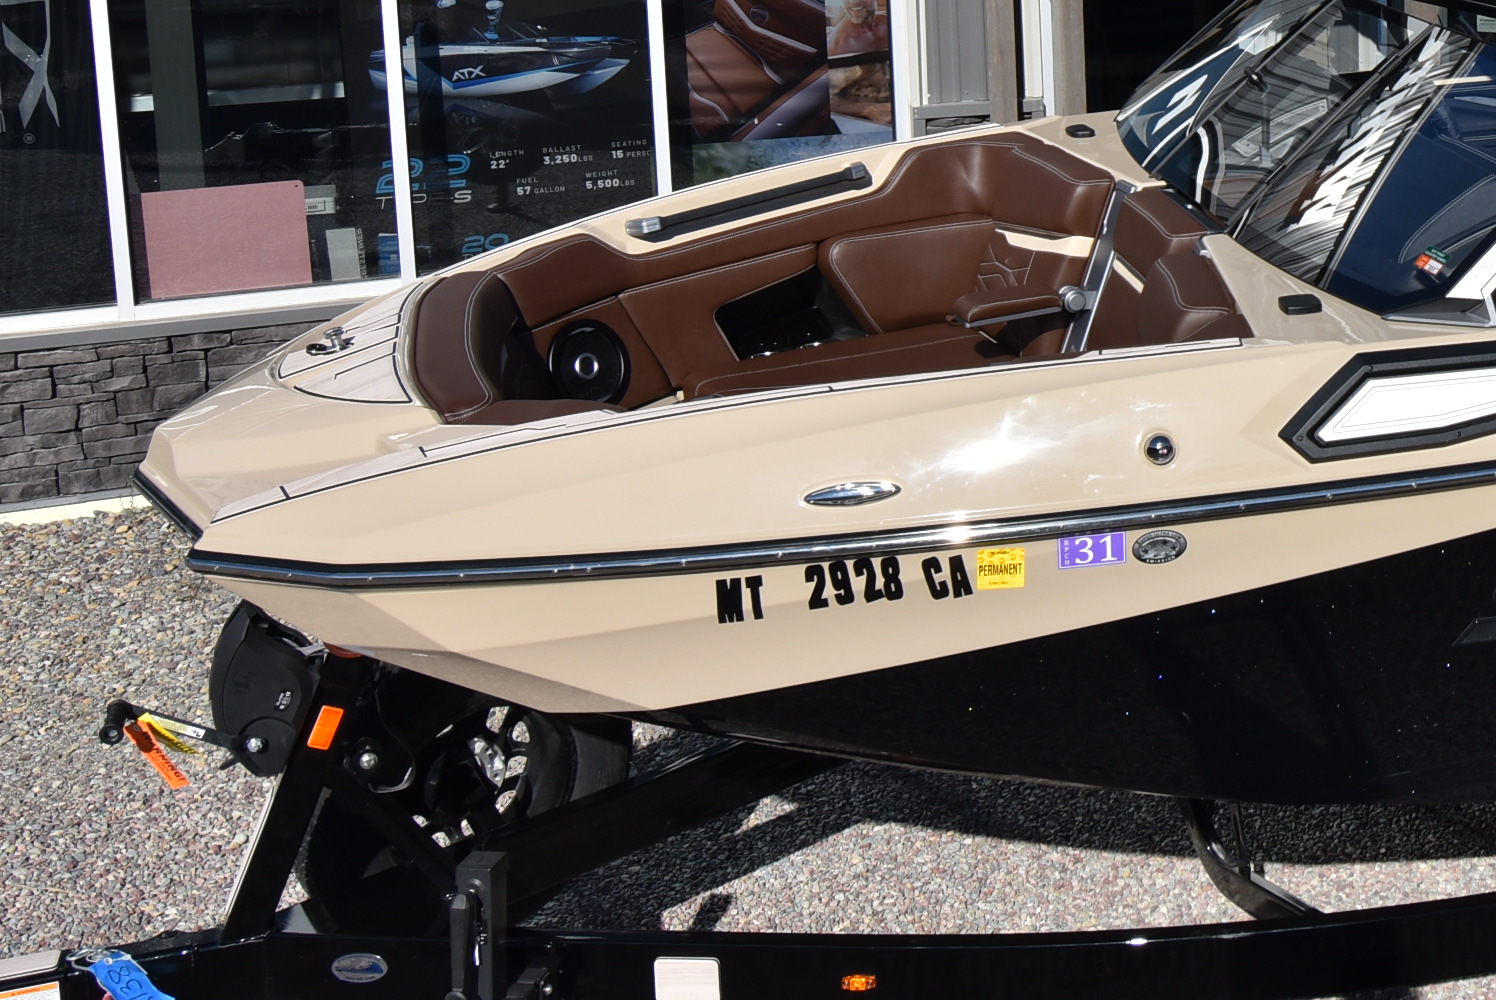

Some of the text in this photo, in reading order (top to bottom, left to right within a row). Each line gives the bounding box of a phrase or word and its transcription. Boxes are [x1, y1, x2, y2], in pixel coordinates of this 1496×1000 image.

[452, 65, 486, 81] ATX
[611, 139, 647, 148] SEATING
[542, 144, 582, 154] BALLAST
[611, 150, 624, 159] 15
[585, 169, 618, 178] WEIGHT
[516, 177, 539, 185] FUEL
[516, 186, 565, 196] 57 GALLON
[462, 233, 509, 253] 20
[1075, 534, 1117, 564] 31
[978, 563, 1023, 577] PERMANENT
[715, 554, 973, 624] MT 2928 CA
